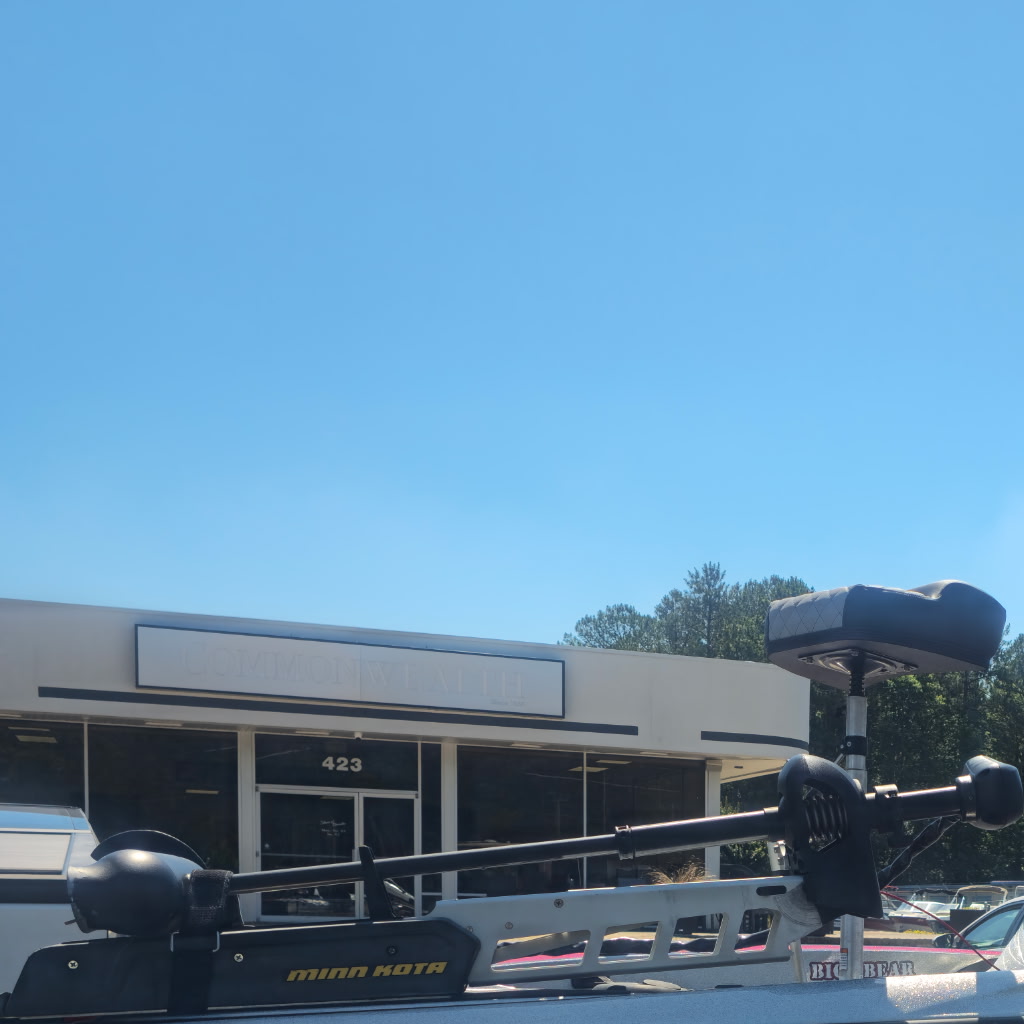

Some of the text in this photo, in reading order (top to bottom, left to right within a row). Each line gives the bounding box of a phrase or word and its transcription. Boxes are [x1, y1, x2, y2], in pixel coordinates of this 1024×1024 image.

[322, 756, 362, 773] 423
[286, 961, 448, 982] MINN KOTA
[862, 960, 916, 978] BEAR
